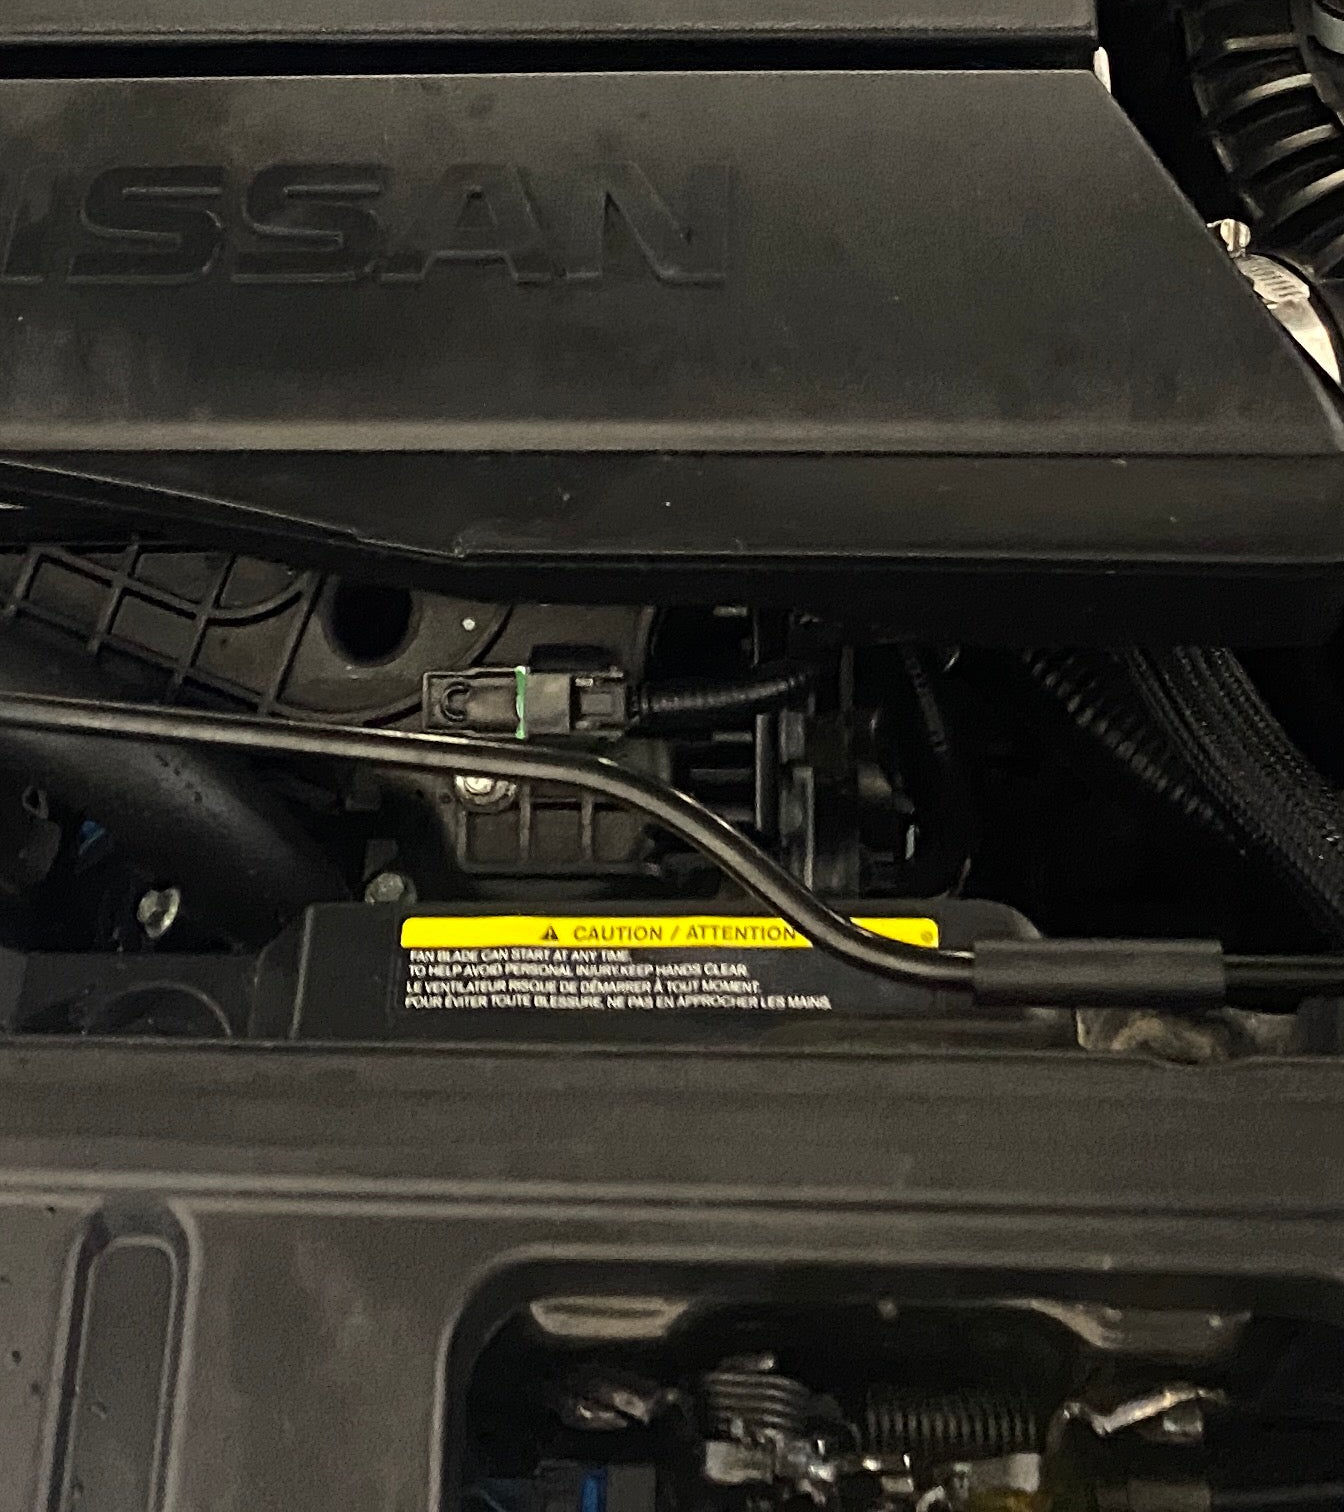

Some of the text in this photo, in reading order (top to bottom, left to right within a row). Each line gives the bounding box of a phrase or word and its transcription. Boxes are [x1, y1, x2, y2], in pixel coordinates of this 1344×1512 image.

[573, 924, 662, 942] CAUTION
[686, 923, 796, 941] ATTENTION
[409, 949, 434, 962] FAN
[437, 949, 478, 962] BLADE
[480, 949, 508, 962] CAN
[510, 949, 549, 962] START
[553, 949, 568, 962] AT
[570, 949, 597, 962] ANY
[409, 963, 426, 977] TO
[428, 963, 462, 977] HELP
[463, 963, 503, 977] AVOID
[505, 963, 573, 977] PERSONAL
[656, 963, 702, 977] HANDS
[406, 979, 423, 994] LE
[425, 979, 506, 994] VENTILATEUR
[509, 979, 556, 994] RISQUE
[559, 979, 577, 994] DE
[580, 978, 652, 994] DÉMARRER
[666, 979, 700, 995] TOUT
[405, 995, 442, 1009] POUR
[491, 995, 531, 1010] TOUTE
[607, 995, 626, 1010] NE
[627, 995, 654, 1010] PAS
[656, 995, 675, 1010] EN
[676, 995, 758, 1010] APPROCHER
[760, 995, 786, 1010] LES
